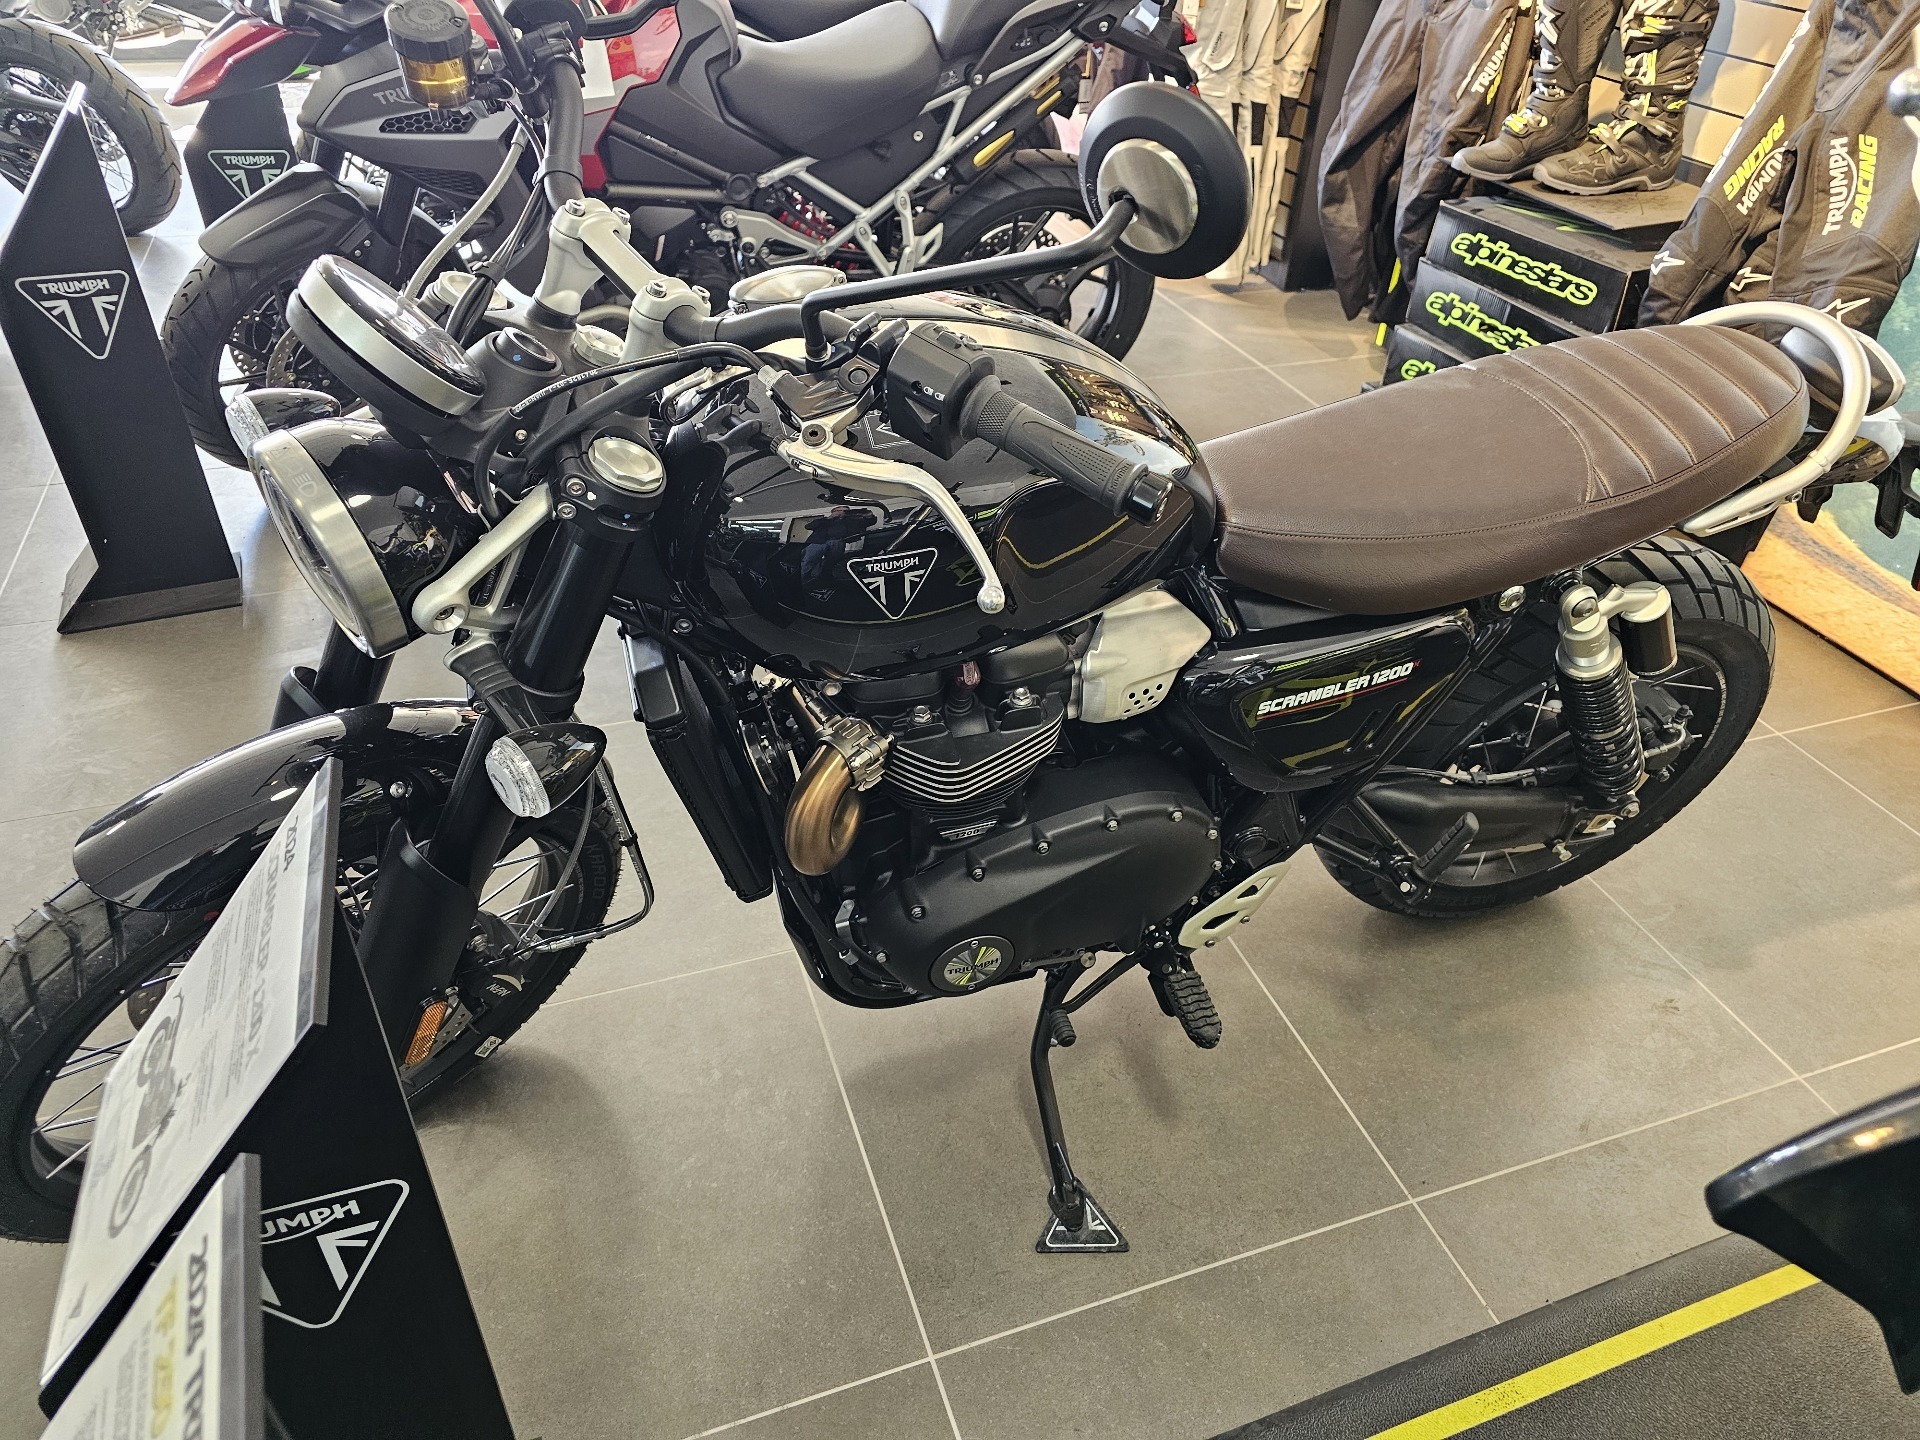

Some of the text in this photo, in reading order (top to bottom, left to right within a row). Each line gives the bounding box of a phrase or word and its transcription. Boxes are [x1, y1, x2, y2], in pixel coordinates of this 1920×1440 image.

[223, 155, 276, 168] TRIUMPH
[1723, 115, 1785, 201] RACING
[1822, 136, 1857, 235] TRIUMPH
[1850, 134, 1878, 228] RACING
[36, 278, 111, 296] TRIUMPH
[1451, 232, 1598, 306] alpinestars
[866, 556, 919, 573] TRIUMPH
[1256, 674, 1370, 715] SCRAMBLER
[955, 828, 980, 838] 1200
[947, 957, 999, 975] TRIUMPH
[261, 1199, 361, 1238] UMPH
